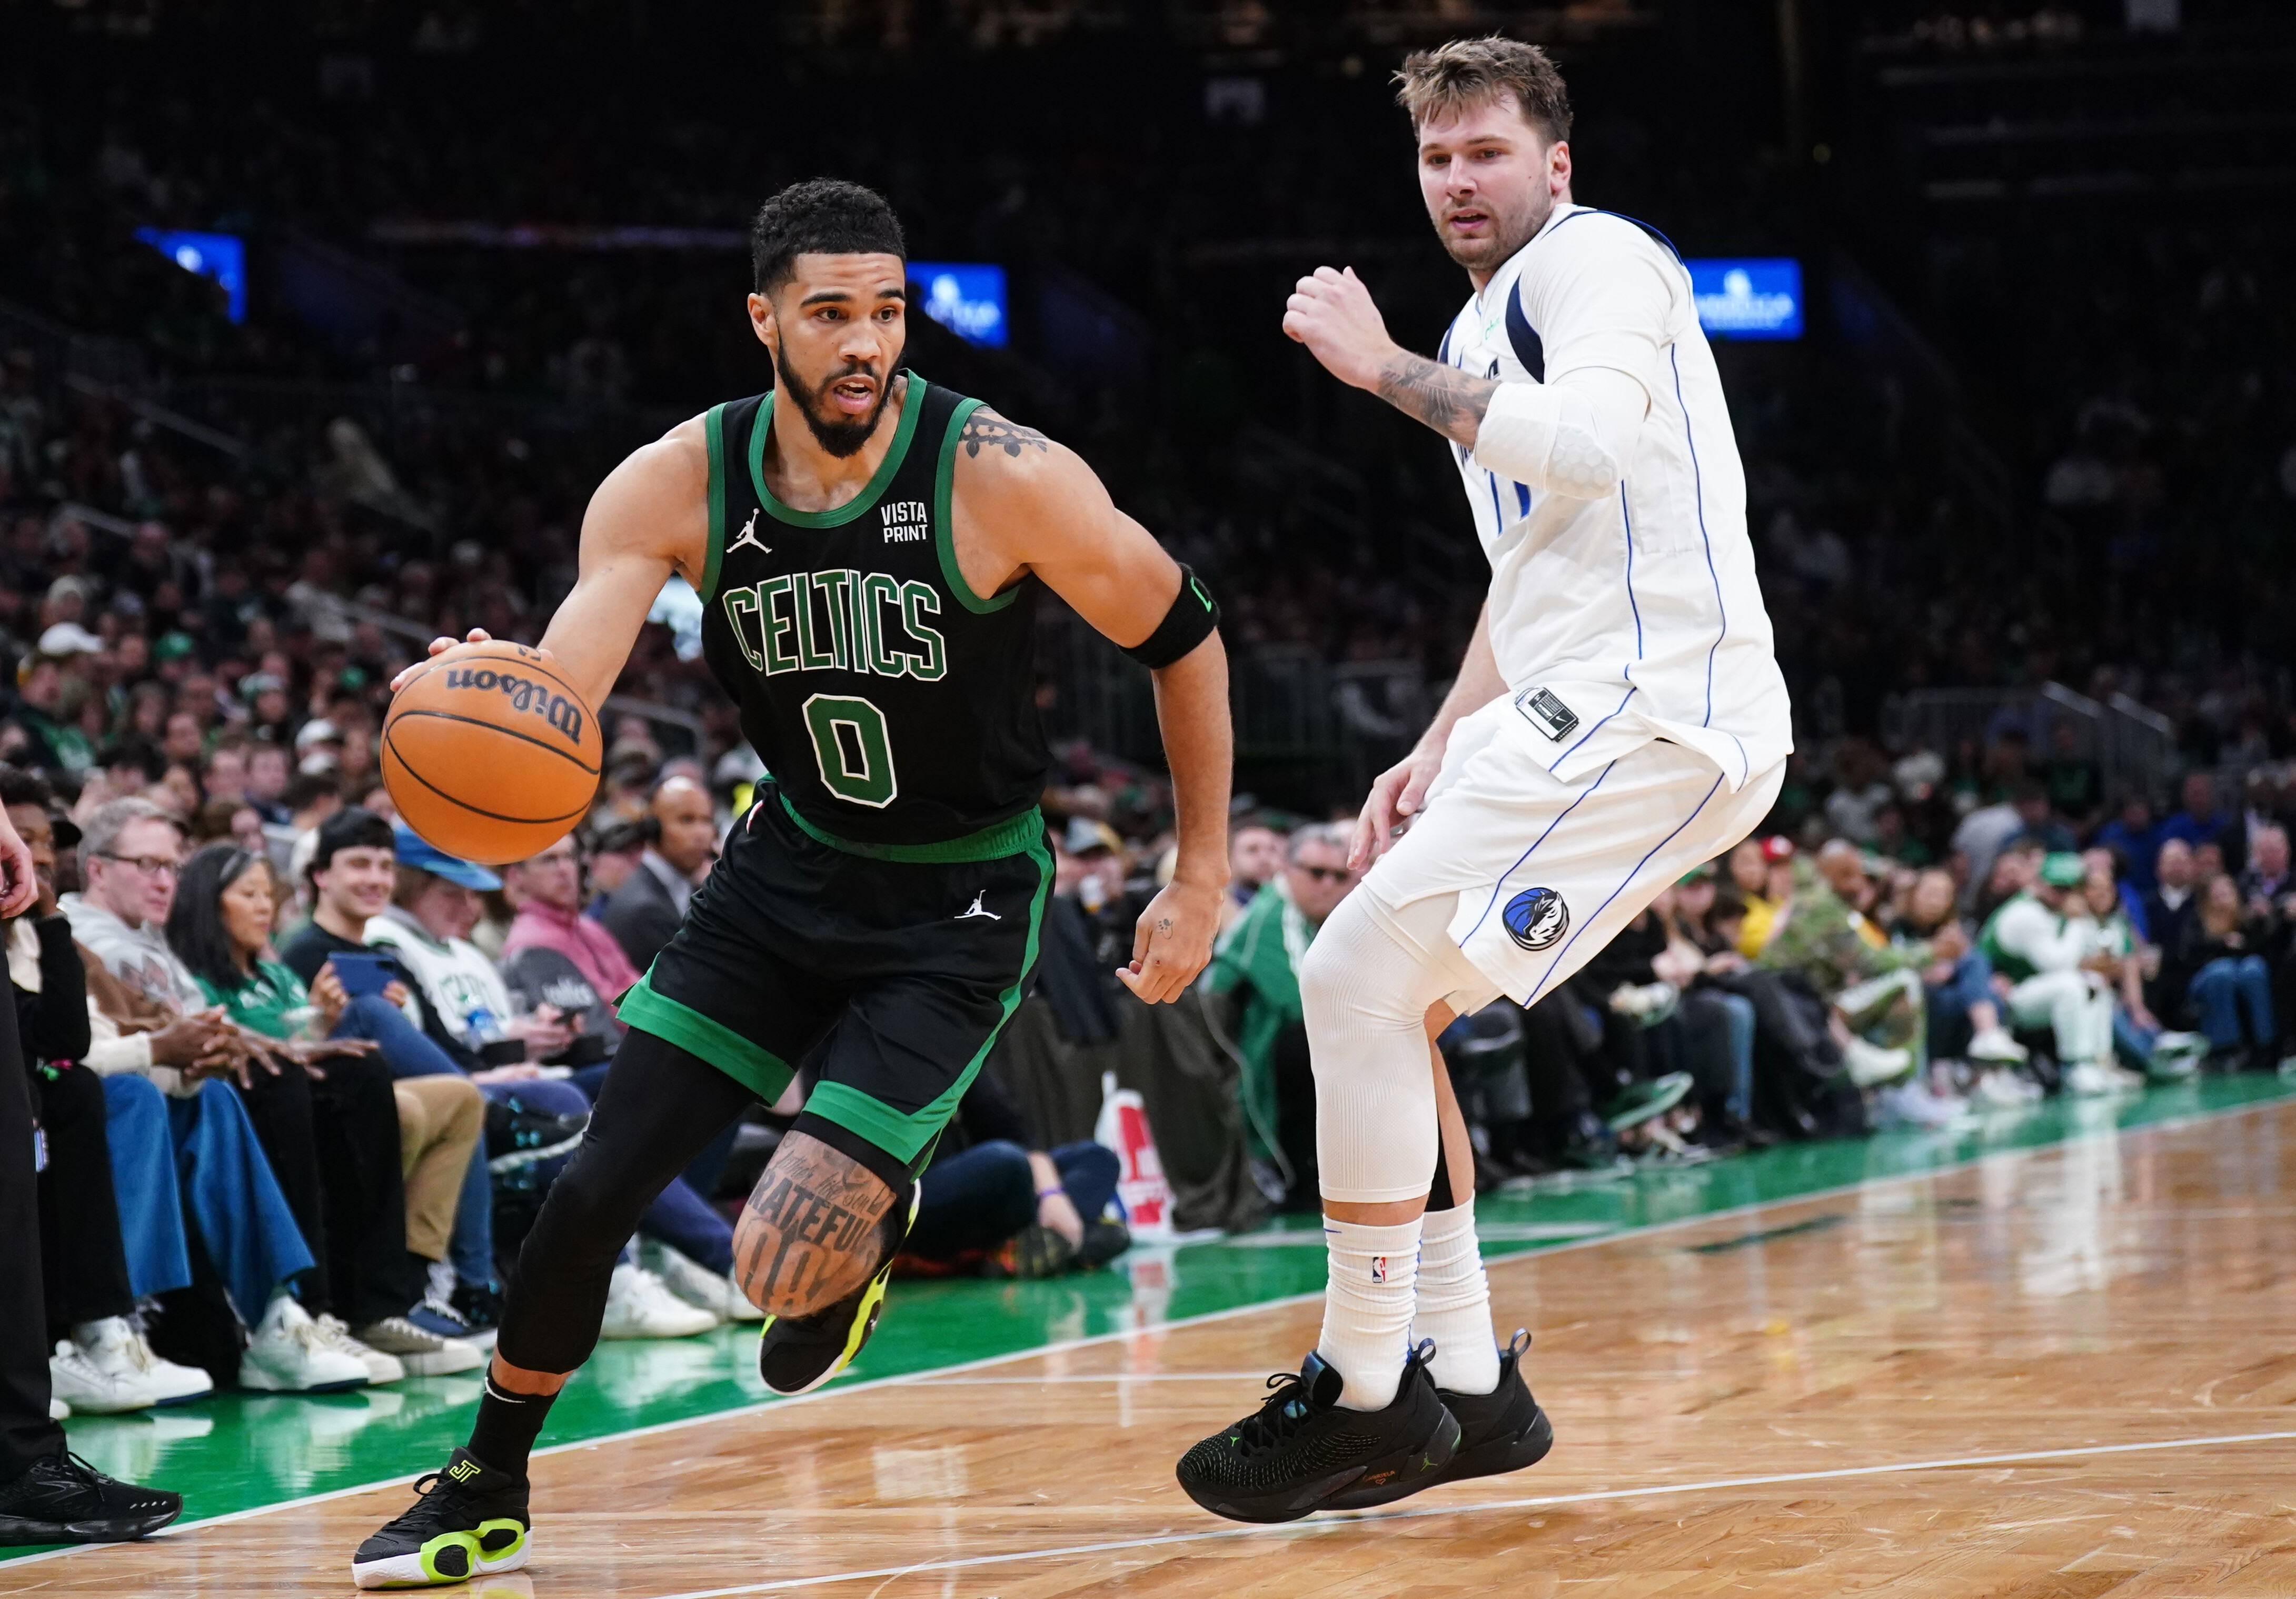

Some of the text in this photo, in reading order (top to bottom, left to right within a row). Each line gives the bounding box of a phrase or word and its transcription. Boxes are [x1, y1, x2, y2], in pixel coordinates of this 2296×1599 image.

[881, 502, 927, 526] VISTA
[883, 524, 928, 543] PRINT
[722, 568, 947, 682] CELTICS
[445, 668, 583, 747] Wilson
[802, 693, 897, 808] 0
[449, 1460, 482, 1483] JT
